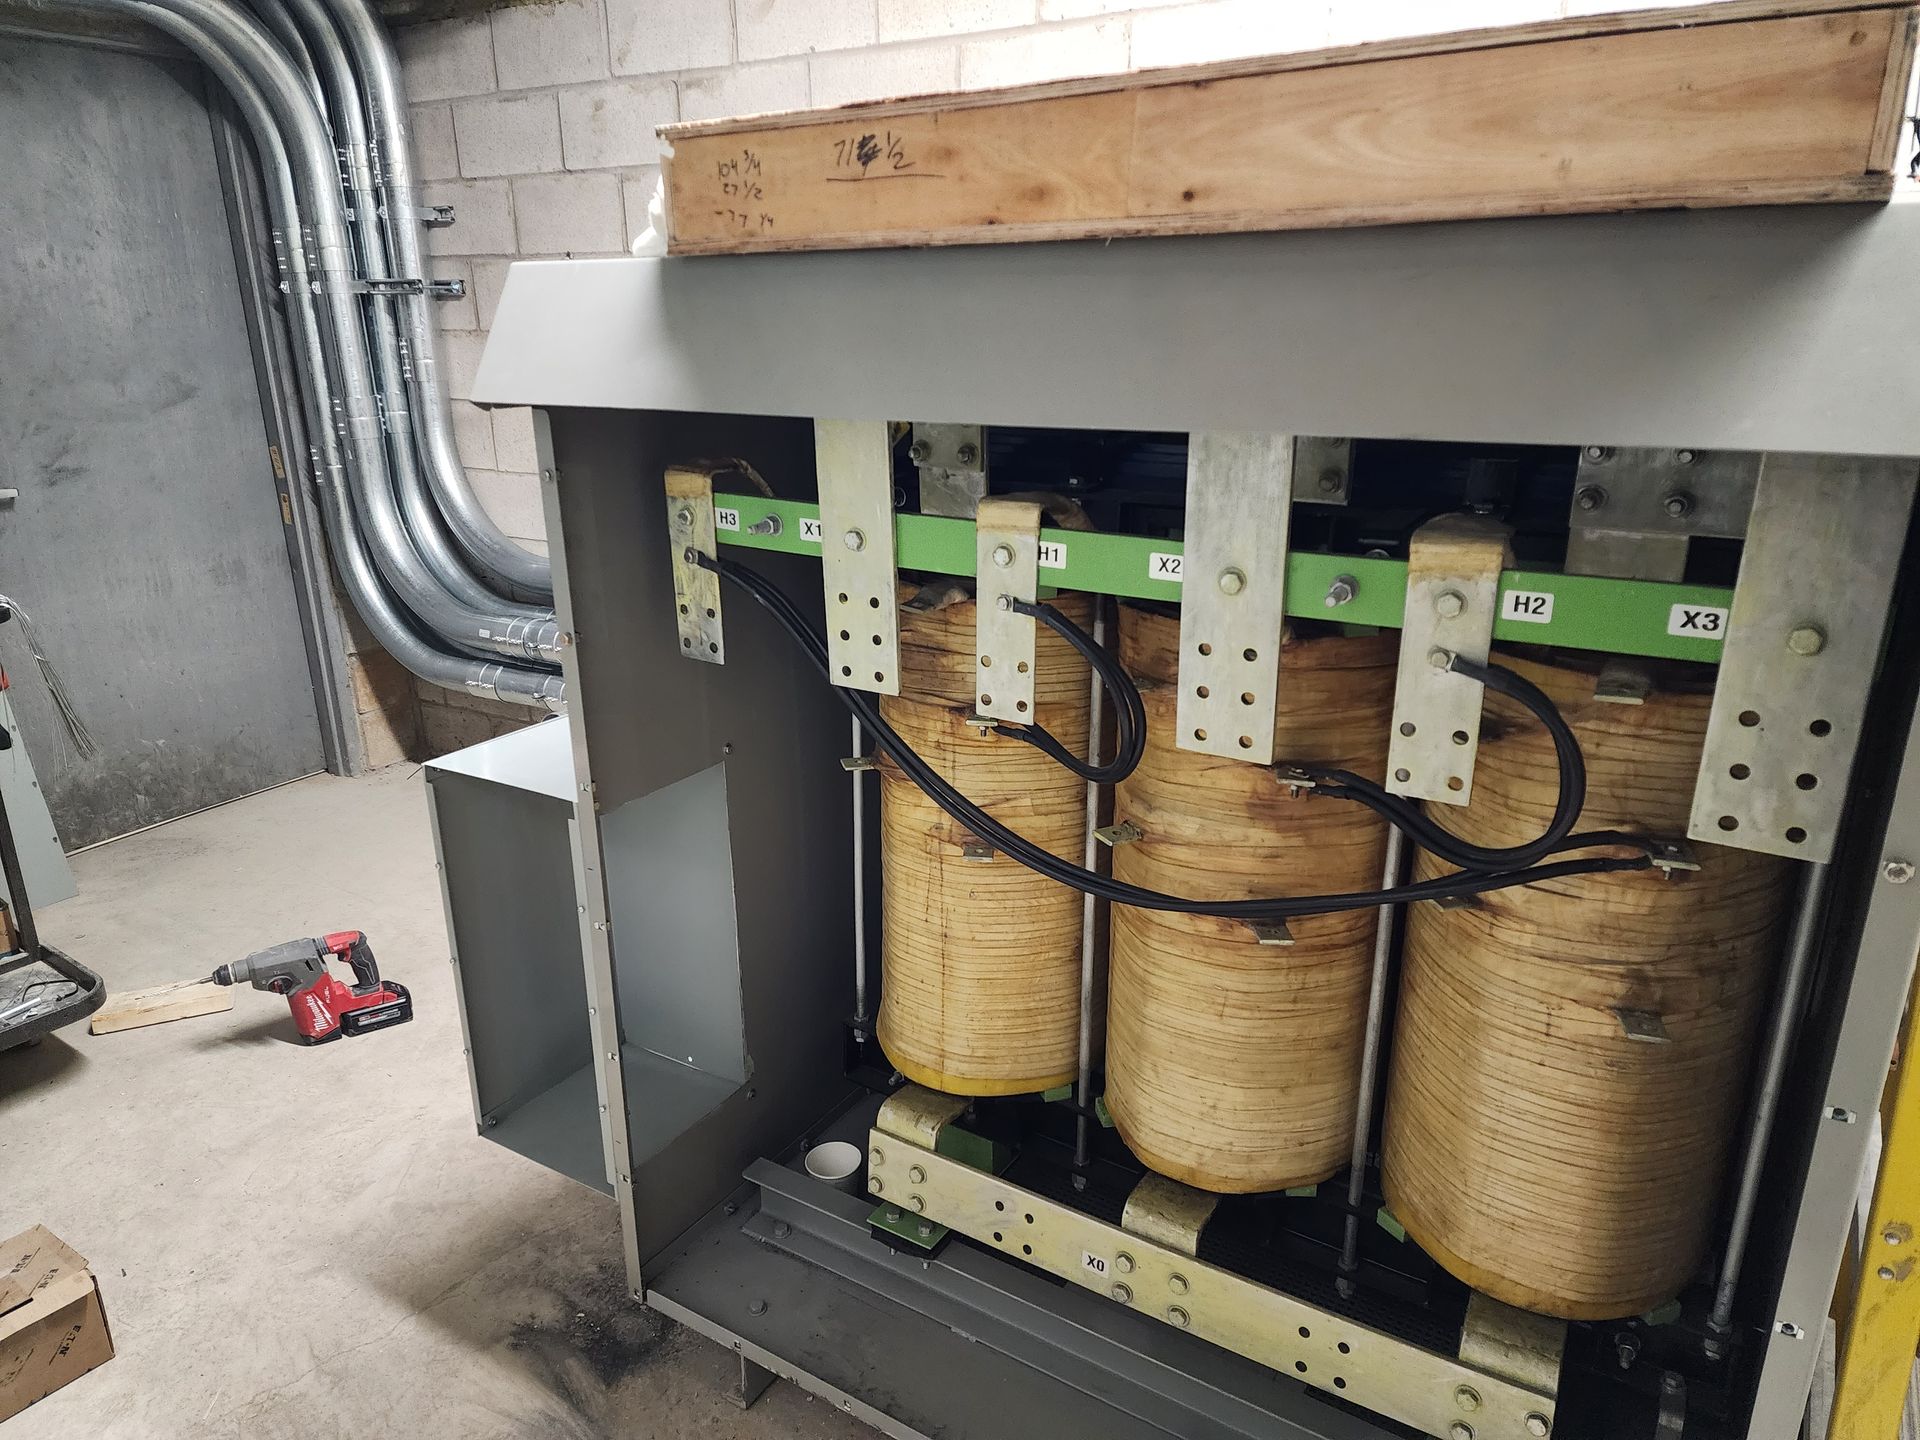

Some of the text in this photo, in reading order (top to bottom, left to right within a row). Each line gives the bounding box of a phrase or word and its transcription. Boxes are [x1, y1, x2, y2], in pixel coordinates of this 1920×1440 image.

[744, 179, 763, 200] 1/2
[719, 511, 737, 527] H3
[804, 521, 822, 537] X1
[1037, 545, 1059, 563] H1
[1158, 556, 1182, 575] X2
[1513, 594, 1547, 615] H2
[1679, 610, 1721, 632] X3
[305, 991, 330, 1032] Milwaukee
